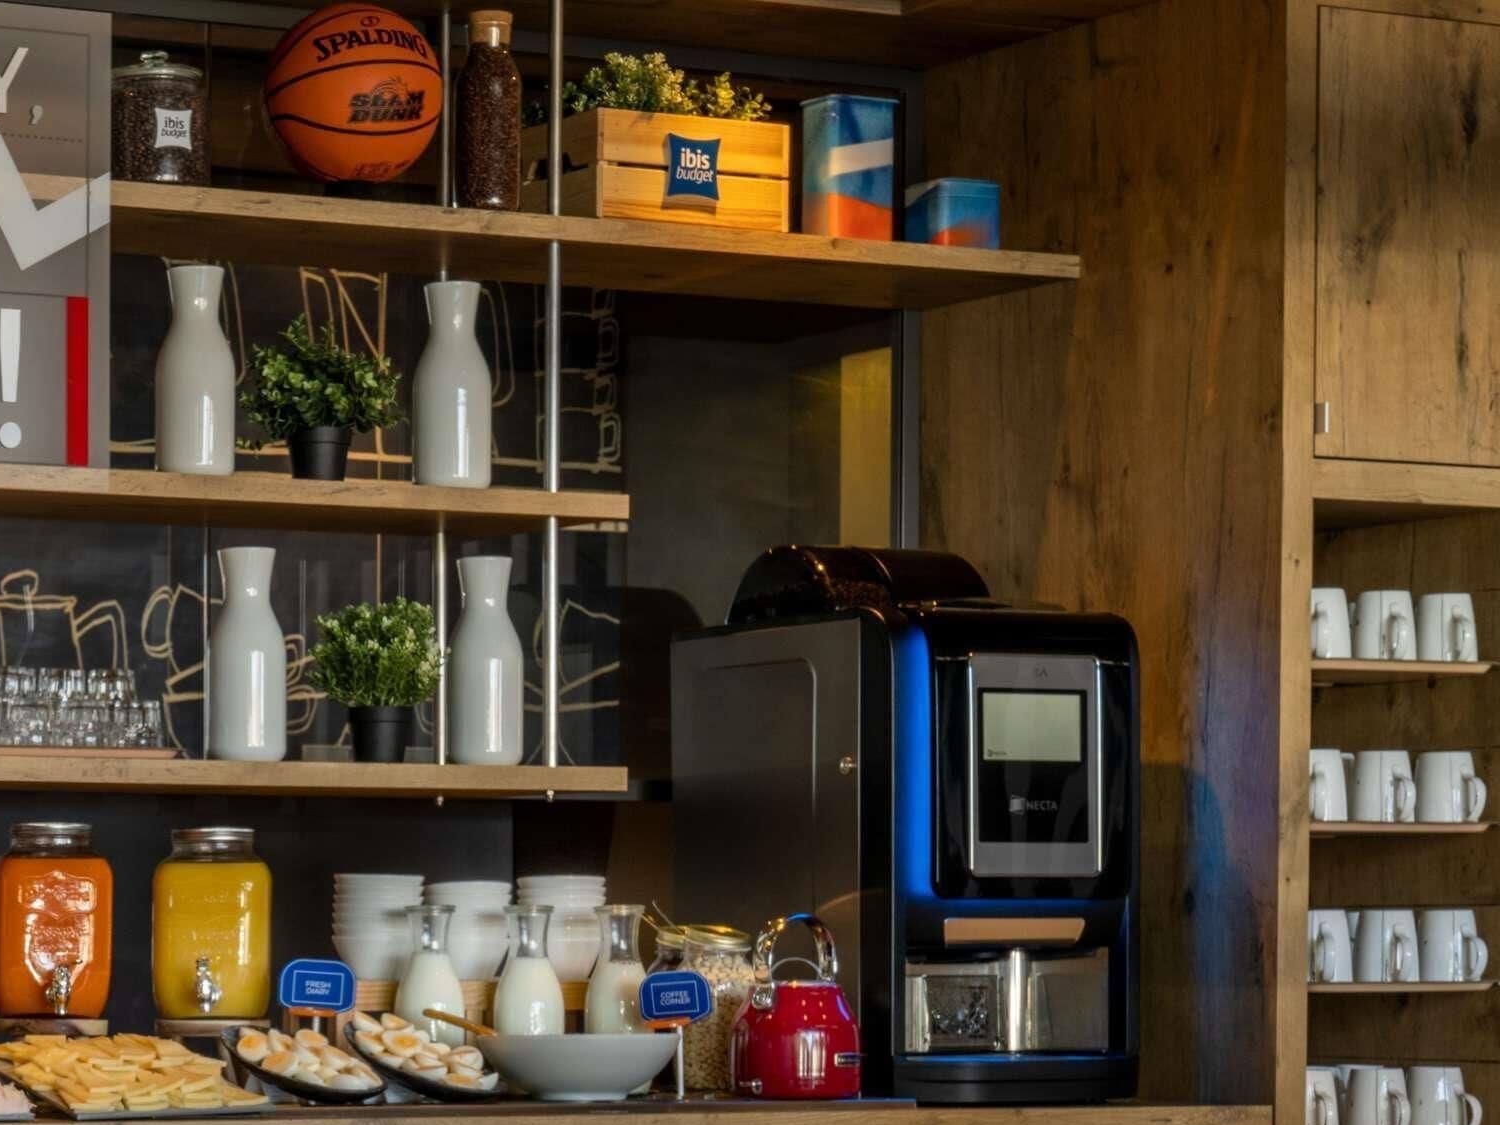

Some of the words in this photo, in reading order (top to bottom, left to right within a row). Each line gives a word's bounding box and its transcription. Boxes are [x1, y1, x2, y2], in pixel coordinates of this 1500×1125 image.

[312, 28, 428, 63] SPALDING
[350, 90, 426, 107] SLAM
[347, 107, 424, 123] DUNK
[164, 116, 186, 130] ibis
[160, 128, 188, 139] budget
[680, 147, 711, 170] ibis
[675, 165, 715, 185] budget
[1025, 799, 1059, 811] NECTA
[305, 980, 332, 988] FRESH
[660, 990, 689, 1000] COFFEE
[660, 997, 692, 1007] CORNER
